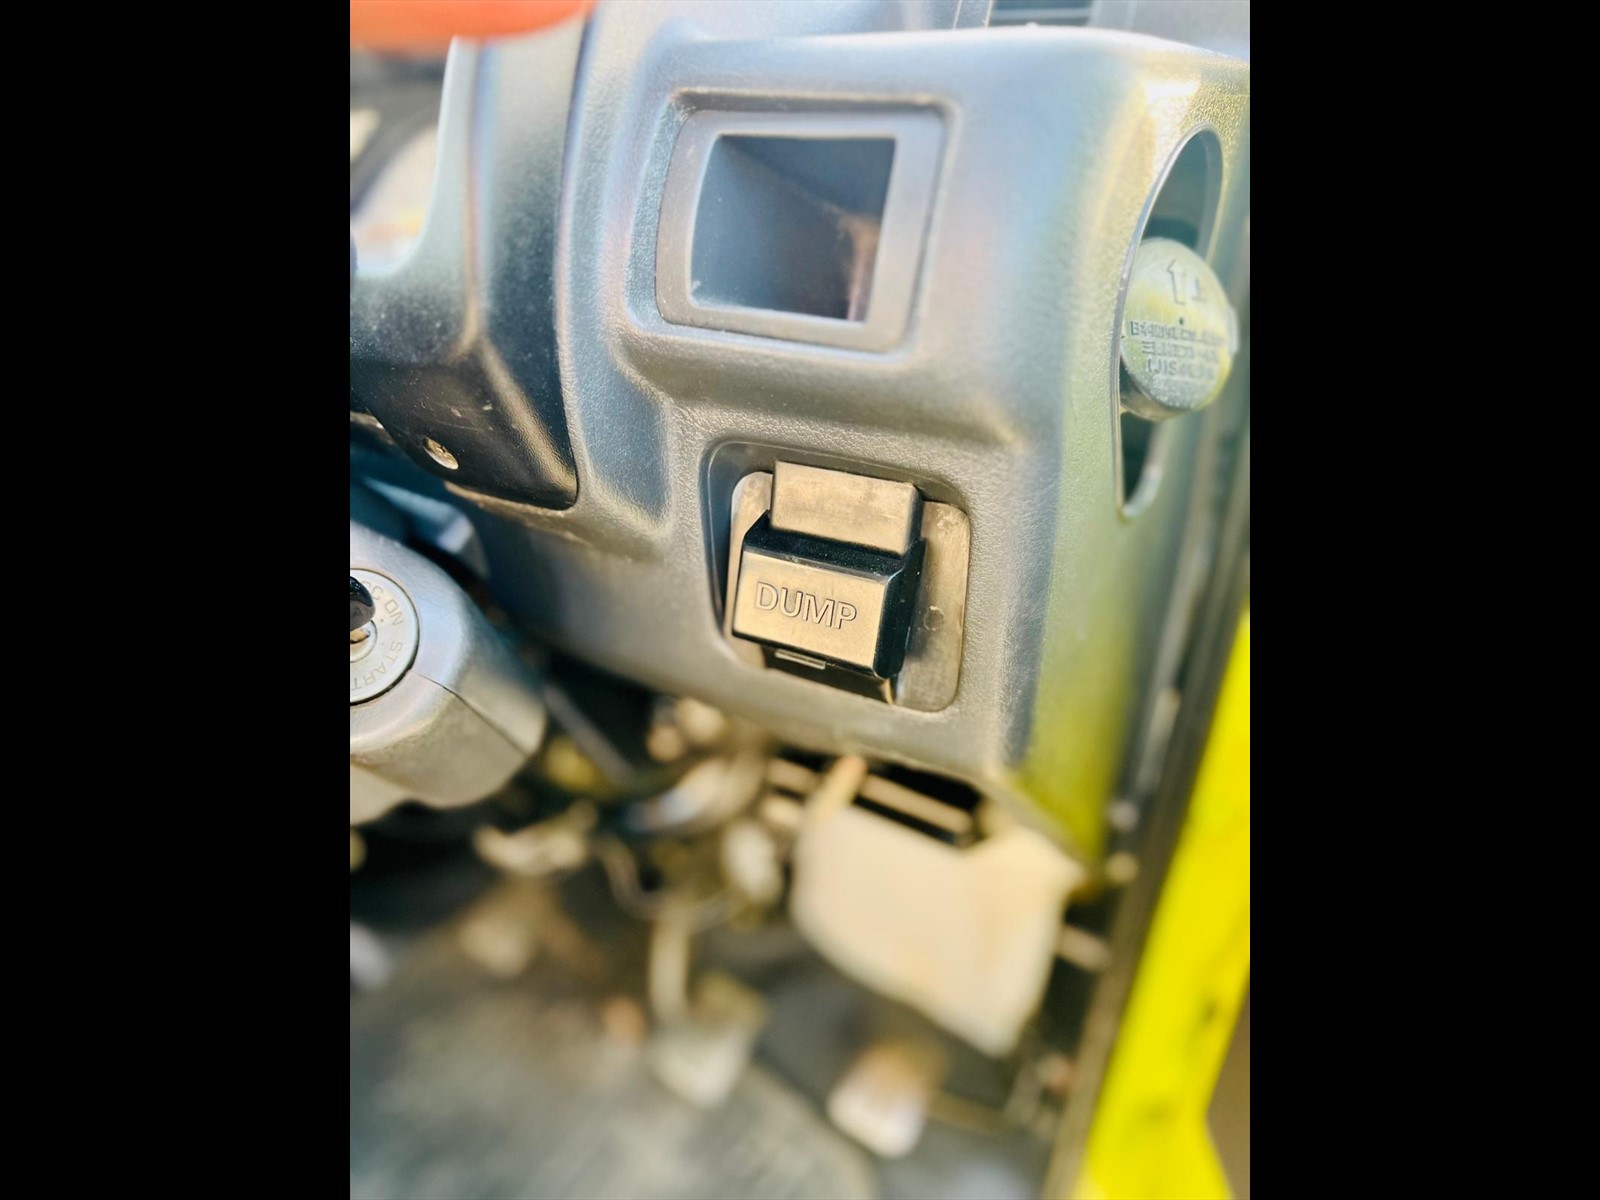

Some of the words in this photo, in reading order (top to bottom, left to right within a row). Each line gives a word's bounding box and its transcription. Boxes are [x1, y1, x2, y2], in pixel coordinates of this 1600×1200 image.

[384, 598, 405, 626] ON
[755, 581, 858, 629] DUMP
[350, 641, 403, 691] START
